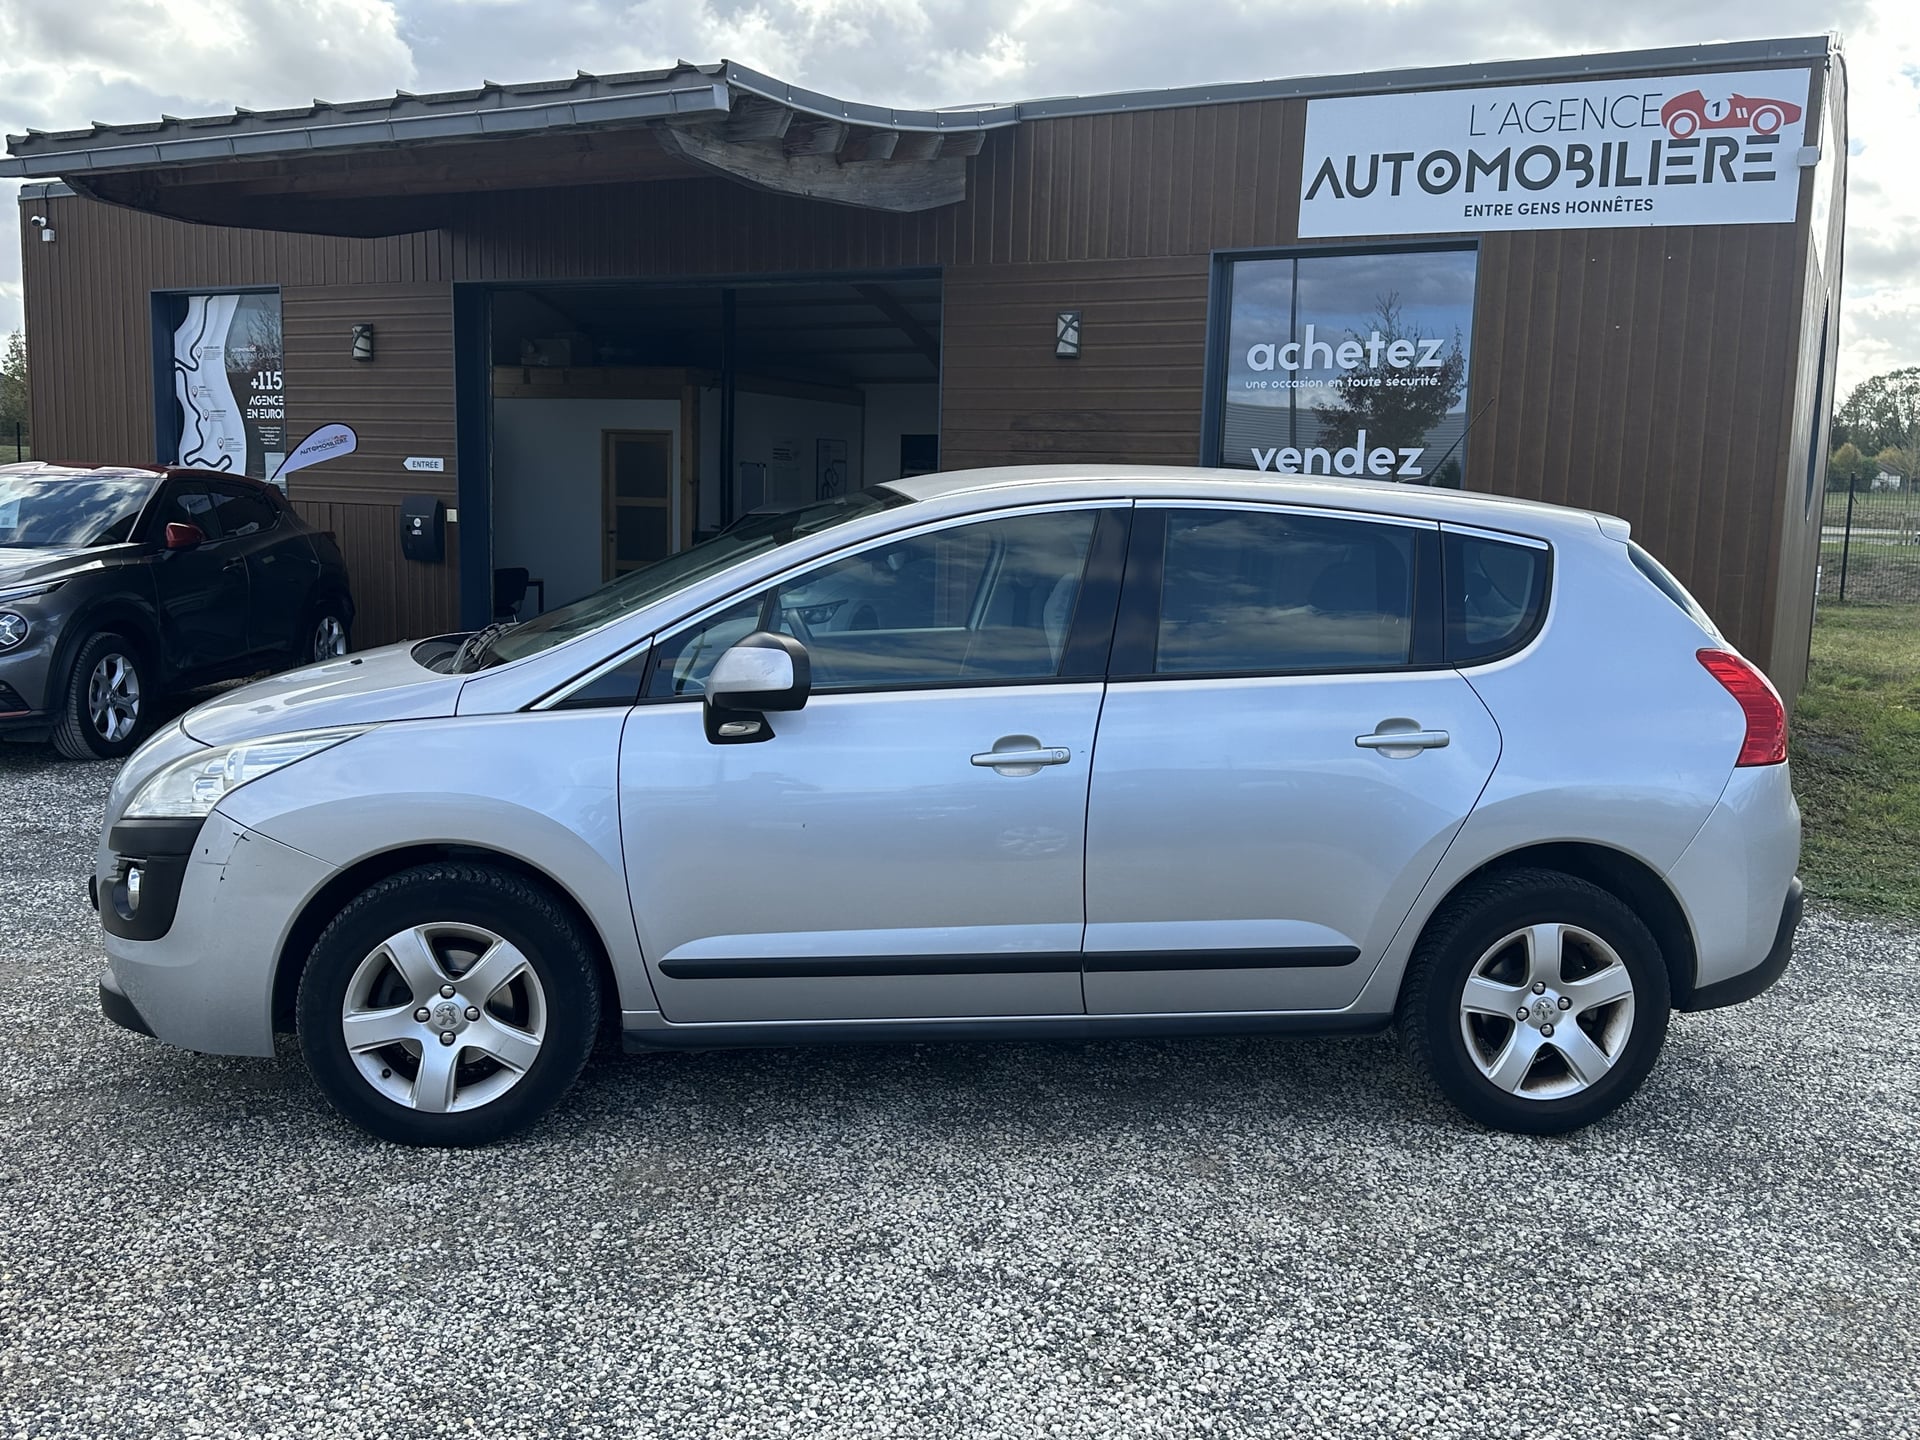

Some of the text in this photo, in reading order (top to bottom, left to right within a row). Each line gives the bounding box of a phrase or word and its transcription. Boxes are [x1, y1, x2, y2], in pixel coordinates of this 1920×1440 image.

[1469, 93, 1663, 136] L'AGENCE
[1710, 101, 1721, 118] 1
[1463, 195, 1654, 217] ENTRE GENS HONNÊTES
[1246, 323, 1445, 372] achetez
[250, 371, 283, 390] +115
[1245, 373, 1442, 389] une occasion en toute sécurité.
[246, 408, 259, 419] EN
[1250, 429, 1425, 475] vendez
[412, 460, 440, 469] ENTRÉE
